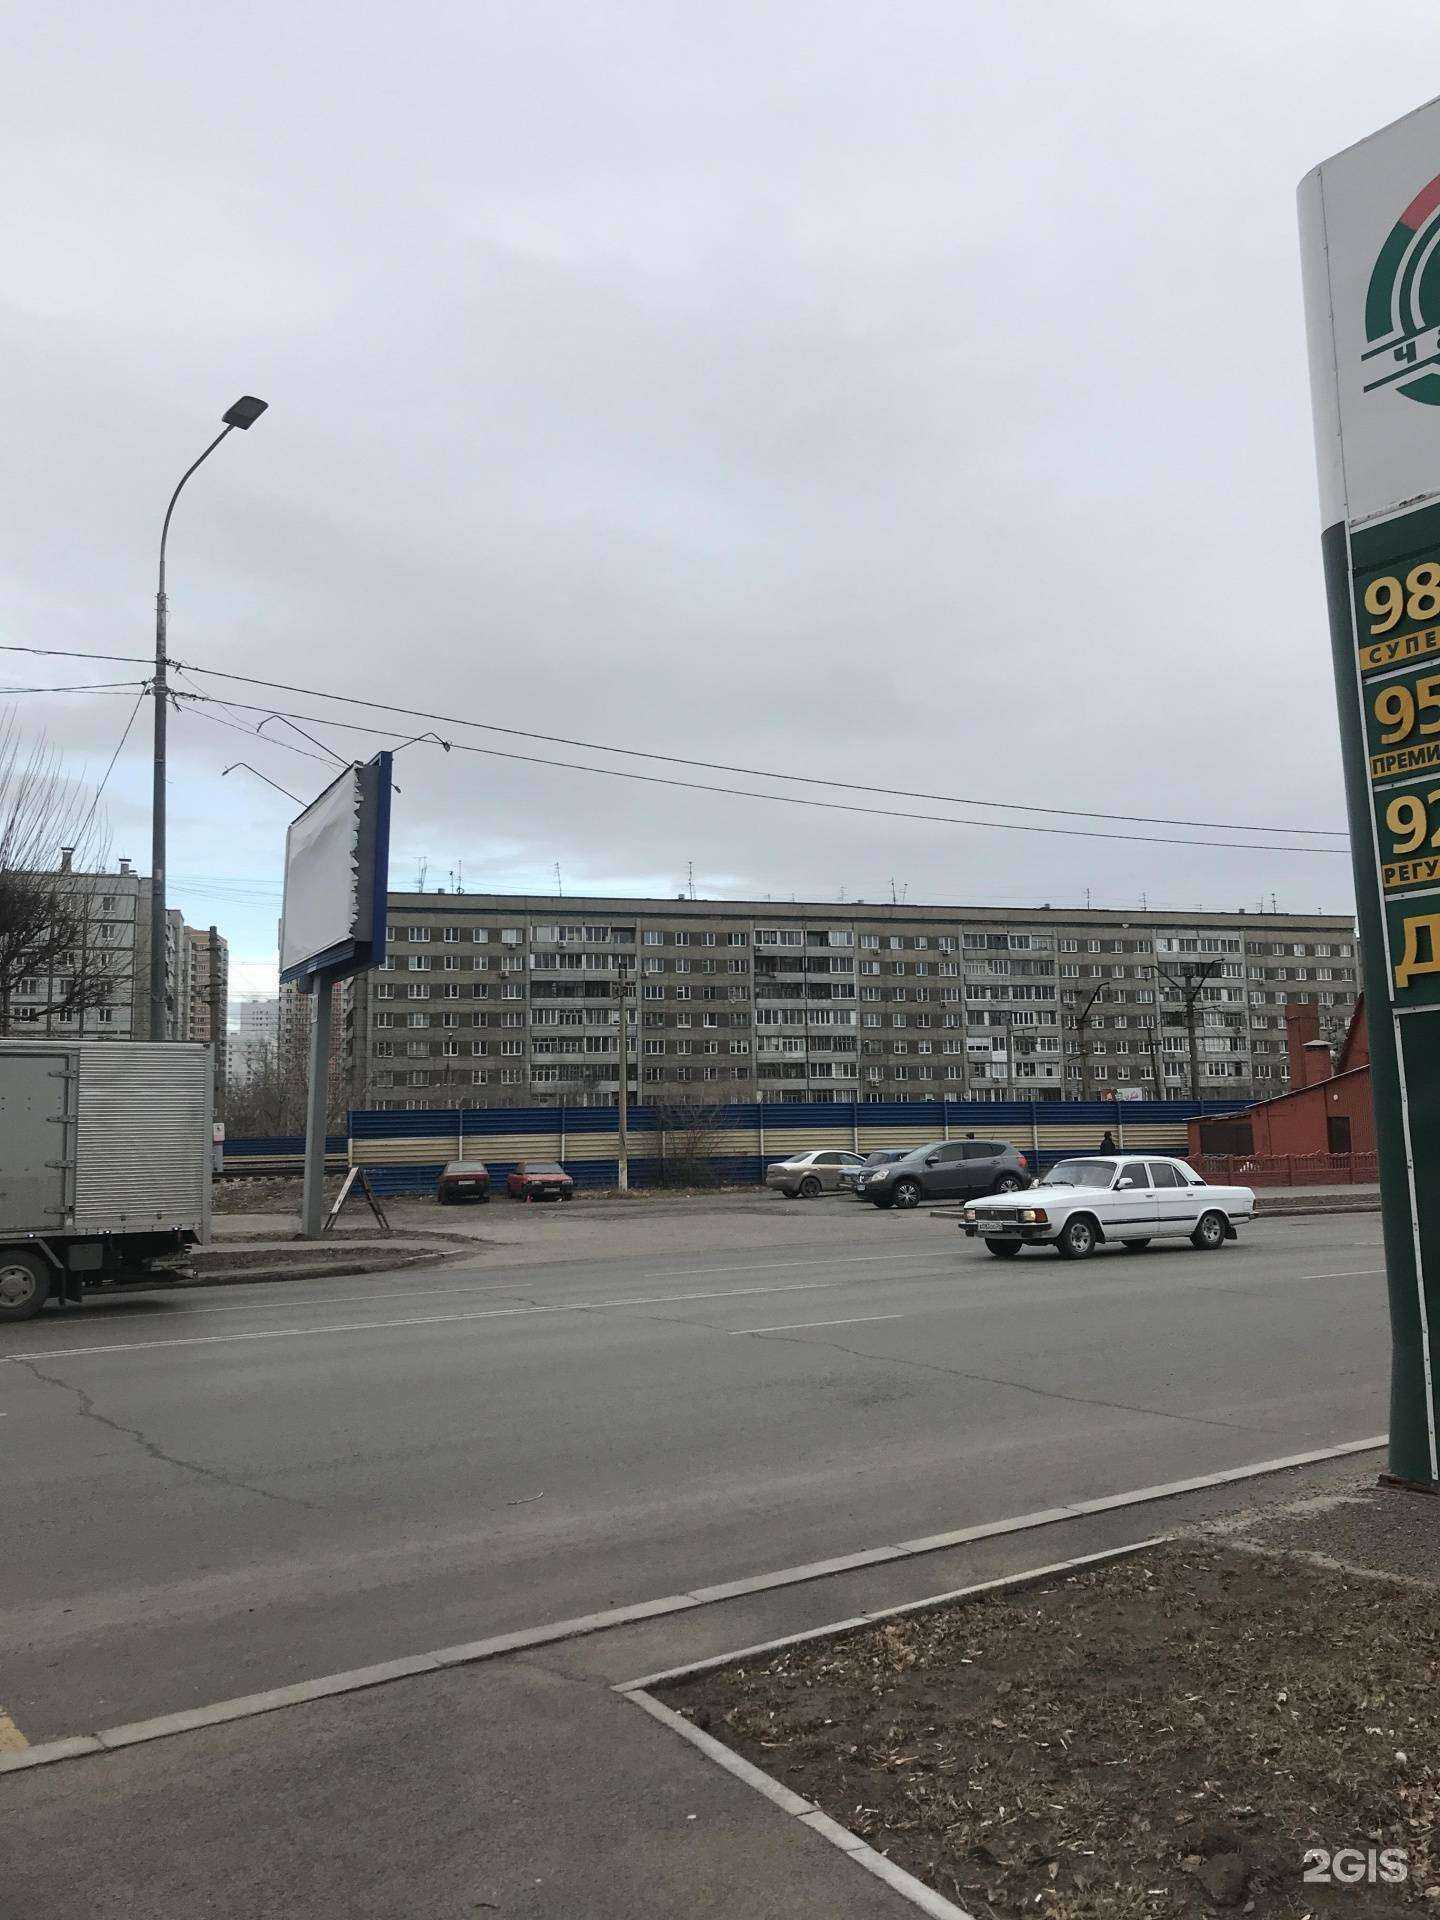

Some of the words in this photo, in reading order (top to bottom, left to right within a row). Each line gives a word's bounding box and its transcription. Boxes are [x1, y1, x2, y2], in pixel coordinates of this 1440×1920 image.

[1364, 562, 1440, 635] 98
[1370, 630, 1438, 663] СУПЕ
[1384, 860, 1439, 884] РЕГУ
